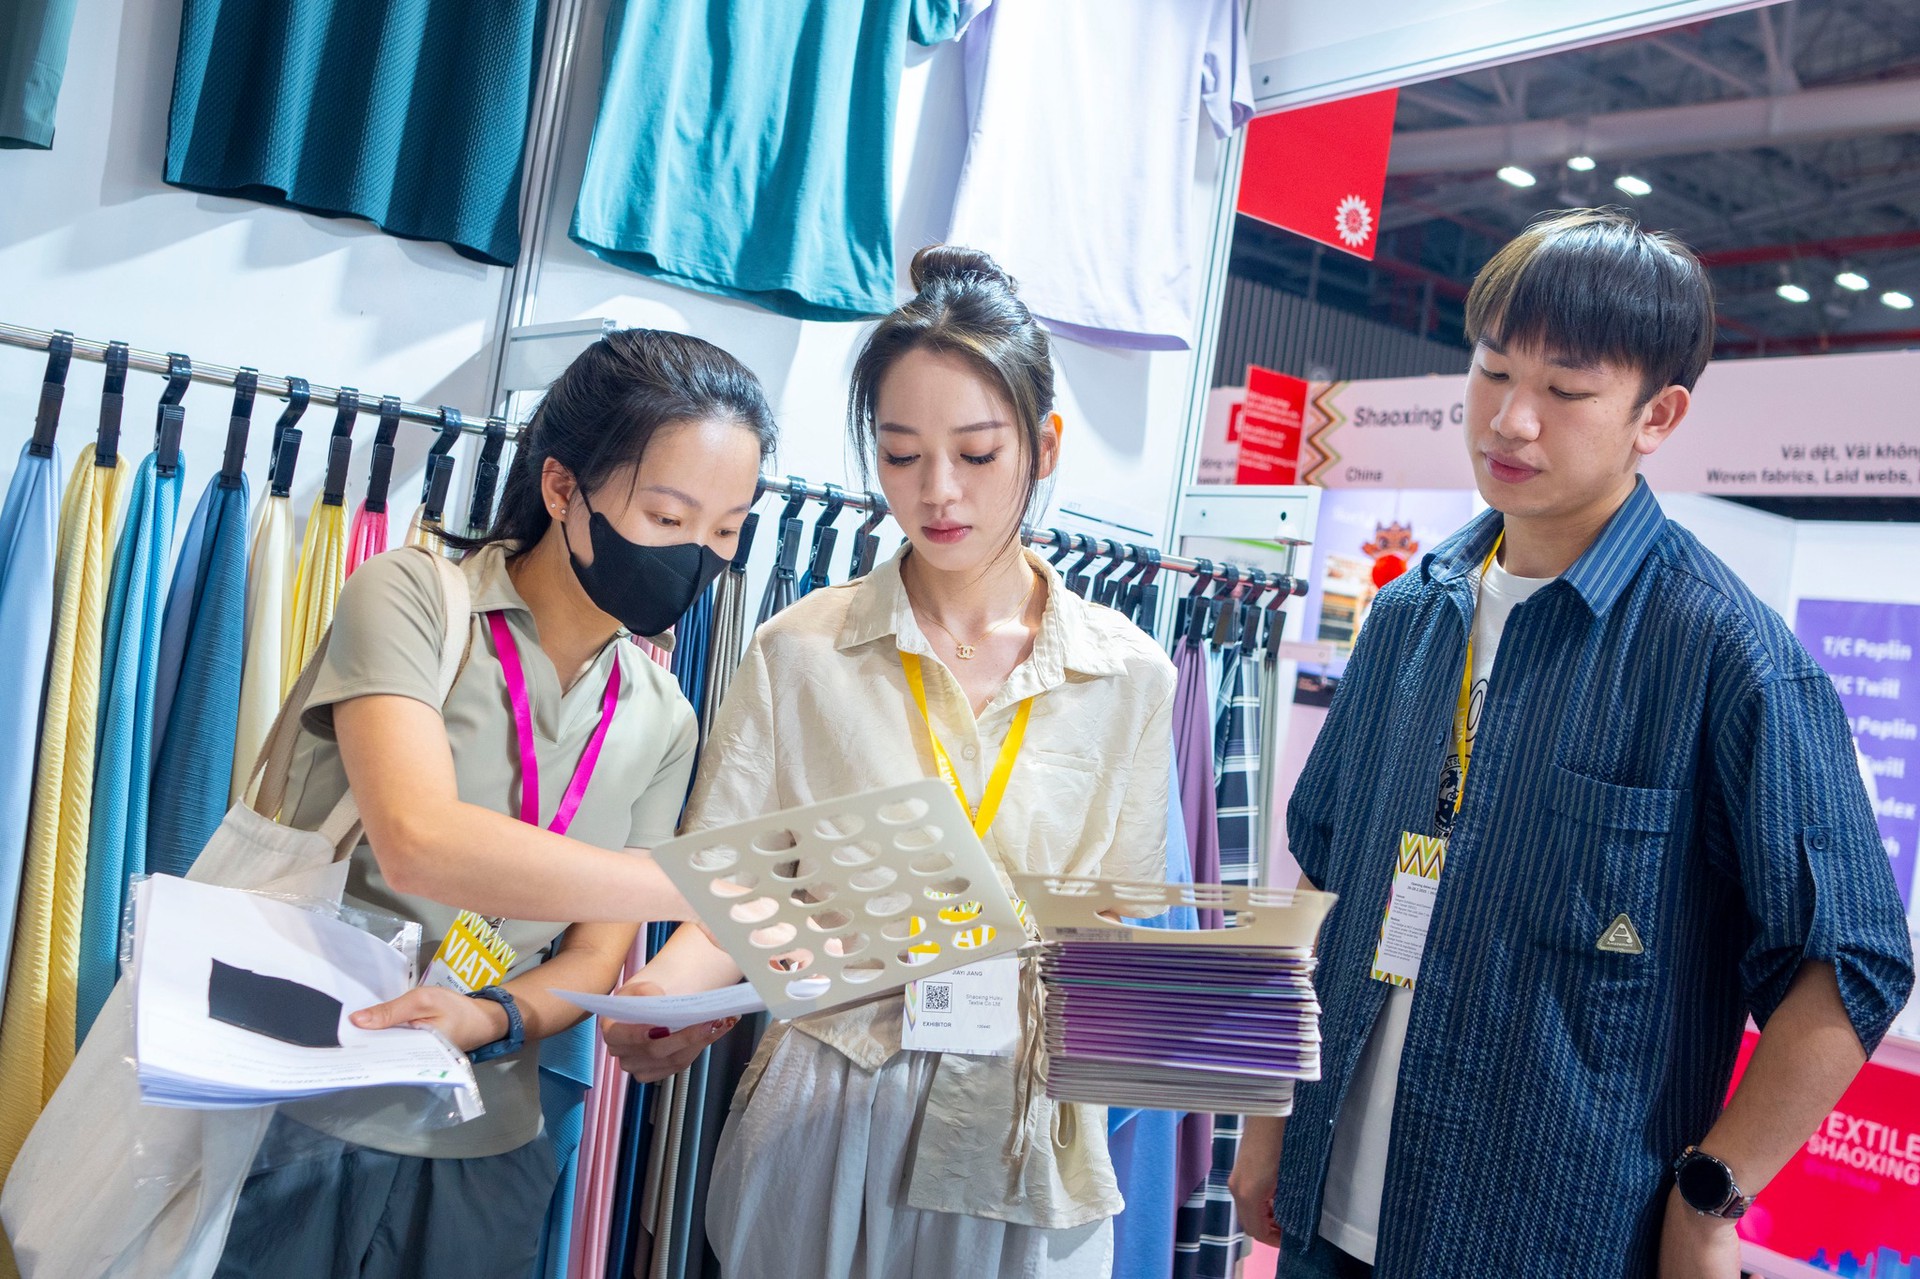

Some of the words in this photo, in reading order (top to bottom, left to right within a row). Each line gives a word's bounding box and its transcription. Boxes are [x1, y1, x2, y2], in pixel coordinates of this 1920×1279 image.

[1354, 404, 1444, 430] Shaoxing
[1346, 465, 1383, 482] China
[1707, 468, 1757, 484] Woven
[1761, 467, 1819, 485] fabrics,
[1824, 469, 1859, 484] Laid
[1865, 468, 1912, 486] webs,
[1823, 635, 1852, 658] T/C
[1854, 638, 1912, 662] Poplin
[1855, 676, 1901, 699] Twill
[1858, 715, 1917, 741] Poplin
[444, 929, 501, 987] VIATT
[1818, 1110, 1920, 1163] EXTILE
[1807, 1133, 1920, 1186] SHAOXING
